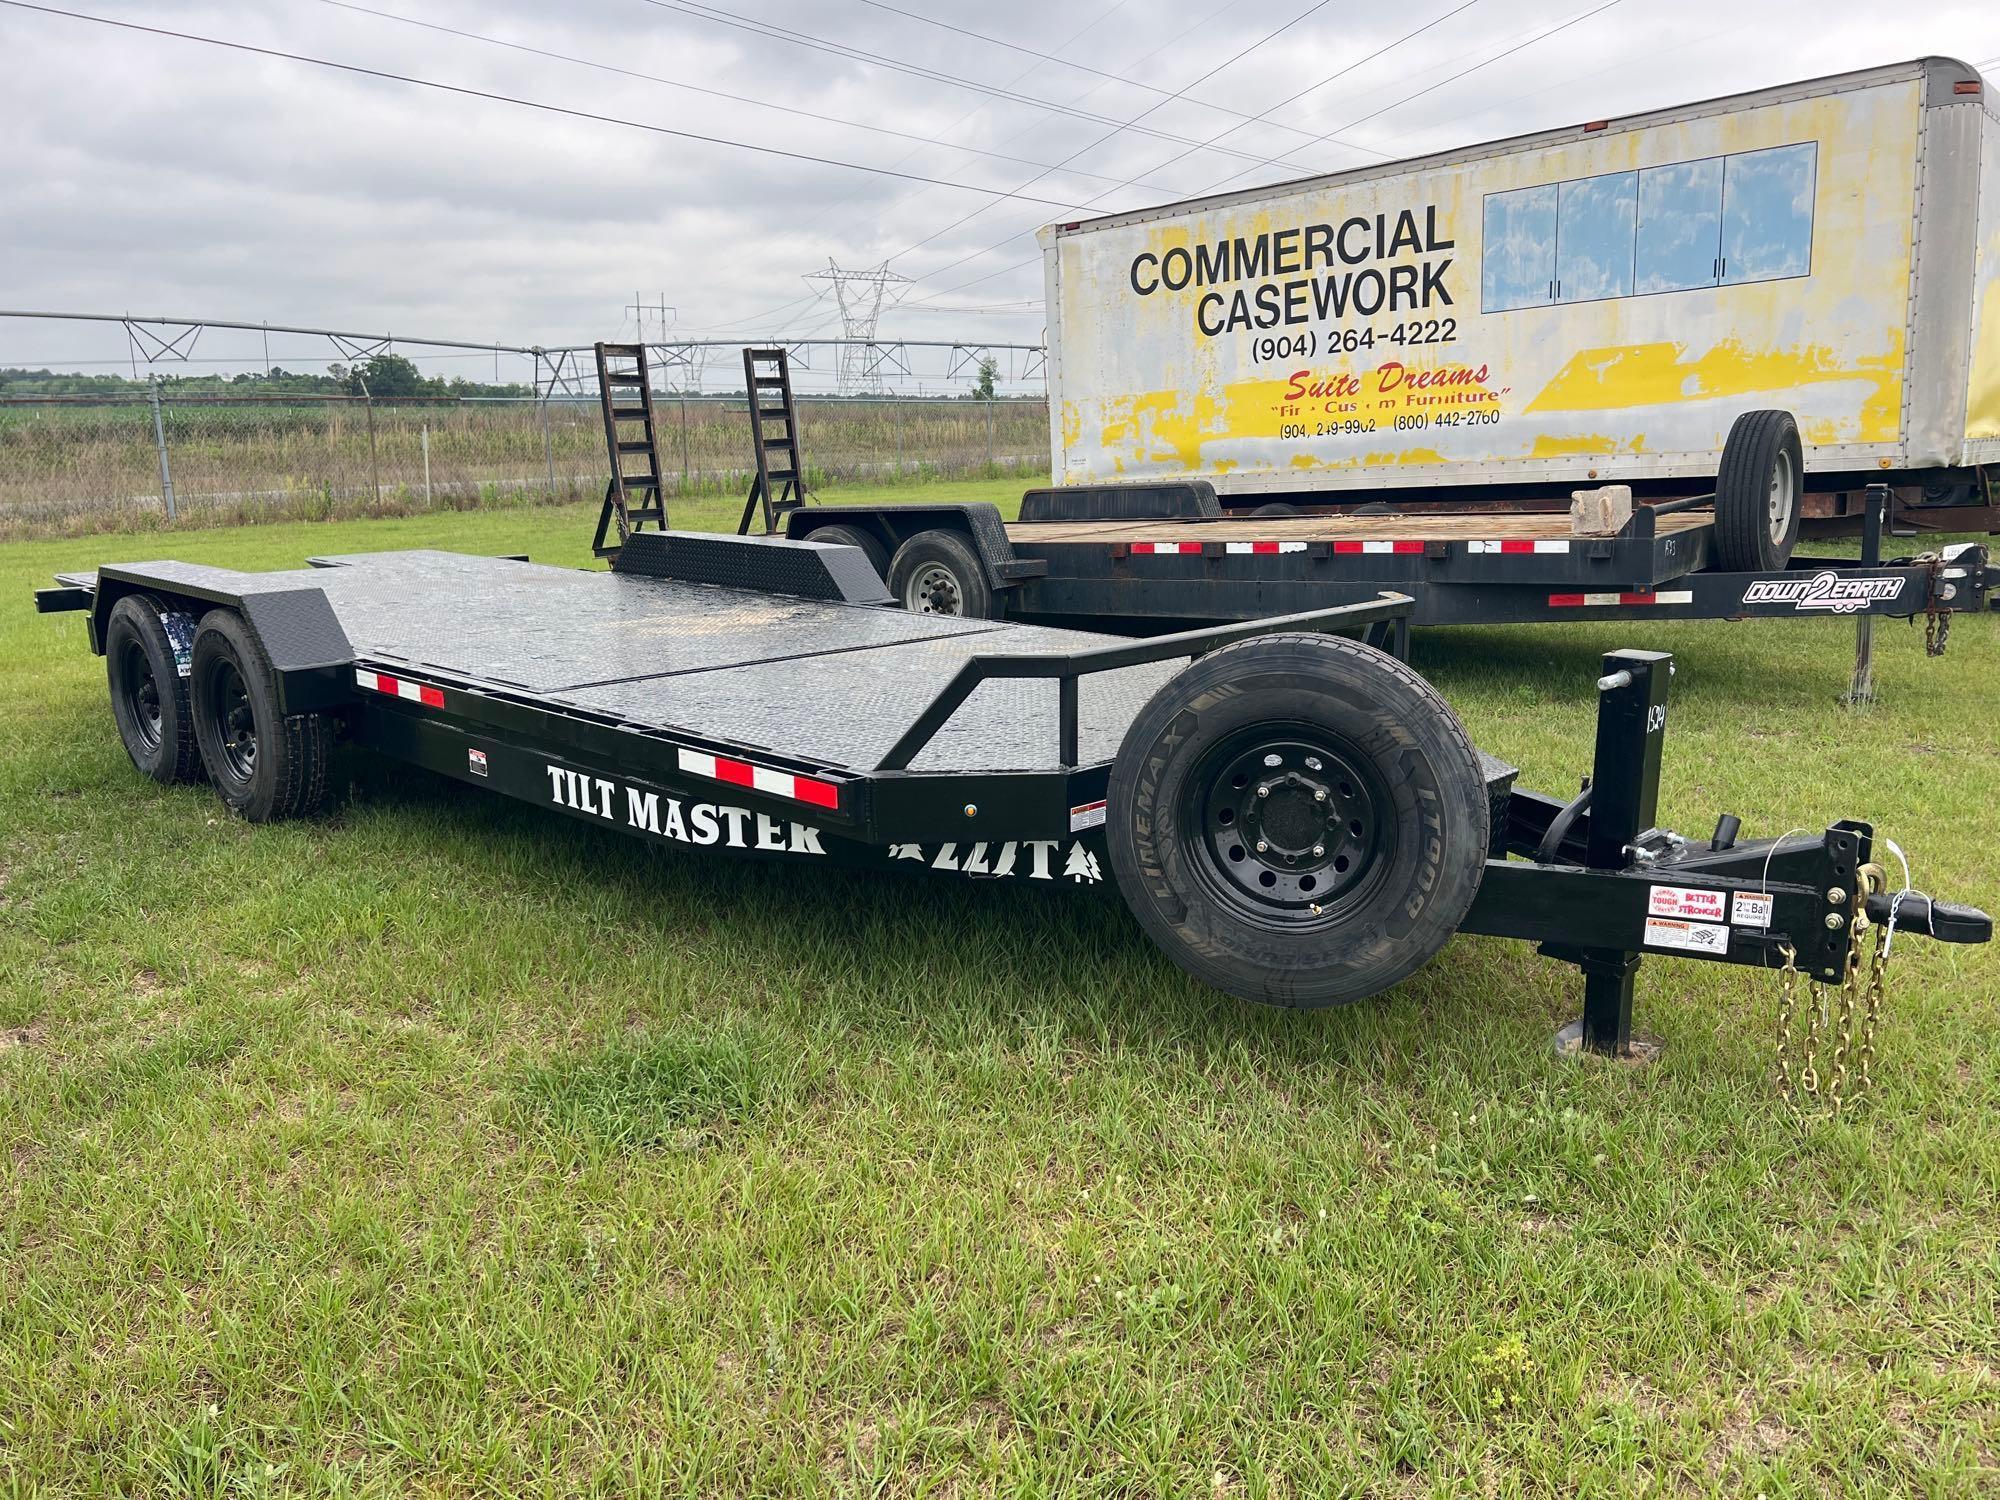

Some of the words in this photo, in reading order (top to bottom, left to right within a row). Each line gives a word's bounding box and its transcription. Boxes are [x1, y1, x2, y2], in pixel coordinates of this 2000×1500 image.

[1130, 205, 1455, 296] COMMERCIAL
[1198, 258, 1454, 337] CASEWORK
[1252, 331, 1317, 363] (904)
[1327, 318, 1457, 354] 264-4222
[1284, 370, 1361, 401] Suite
[1377, 361, 1491, 393] Dreams
[1393, 412, 1429, 432] (800)
[1743, 571, 1905, 608] DOWN2EARTH
[547, 765, 615, 820] TILT
[1653, 896, 1678, 906] TOUGH
[1678, 904, 1722, 917] STRONGER
[1685, 892, 1717, 905] BETTER
[1658, 921, 1686, 929] WARNING
